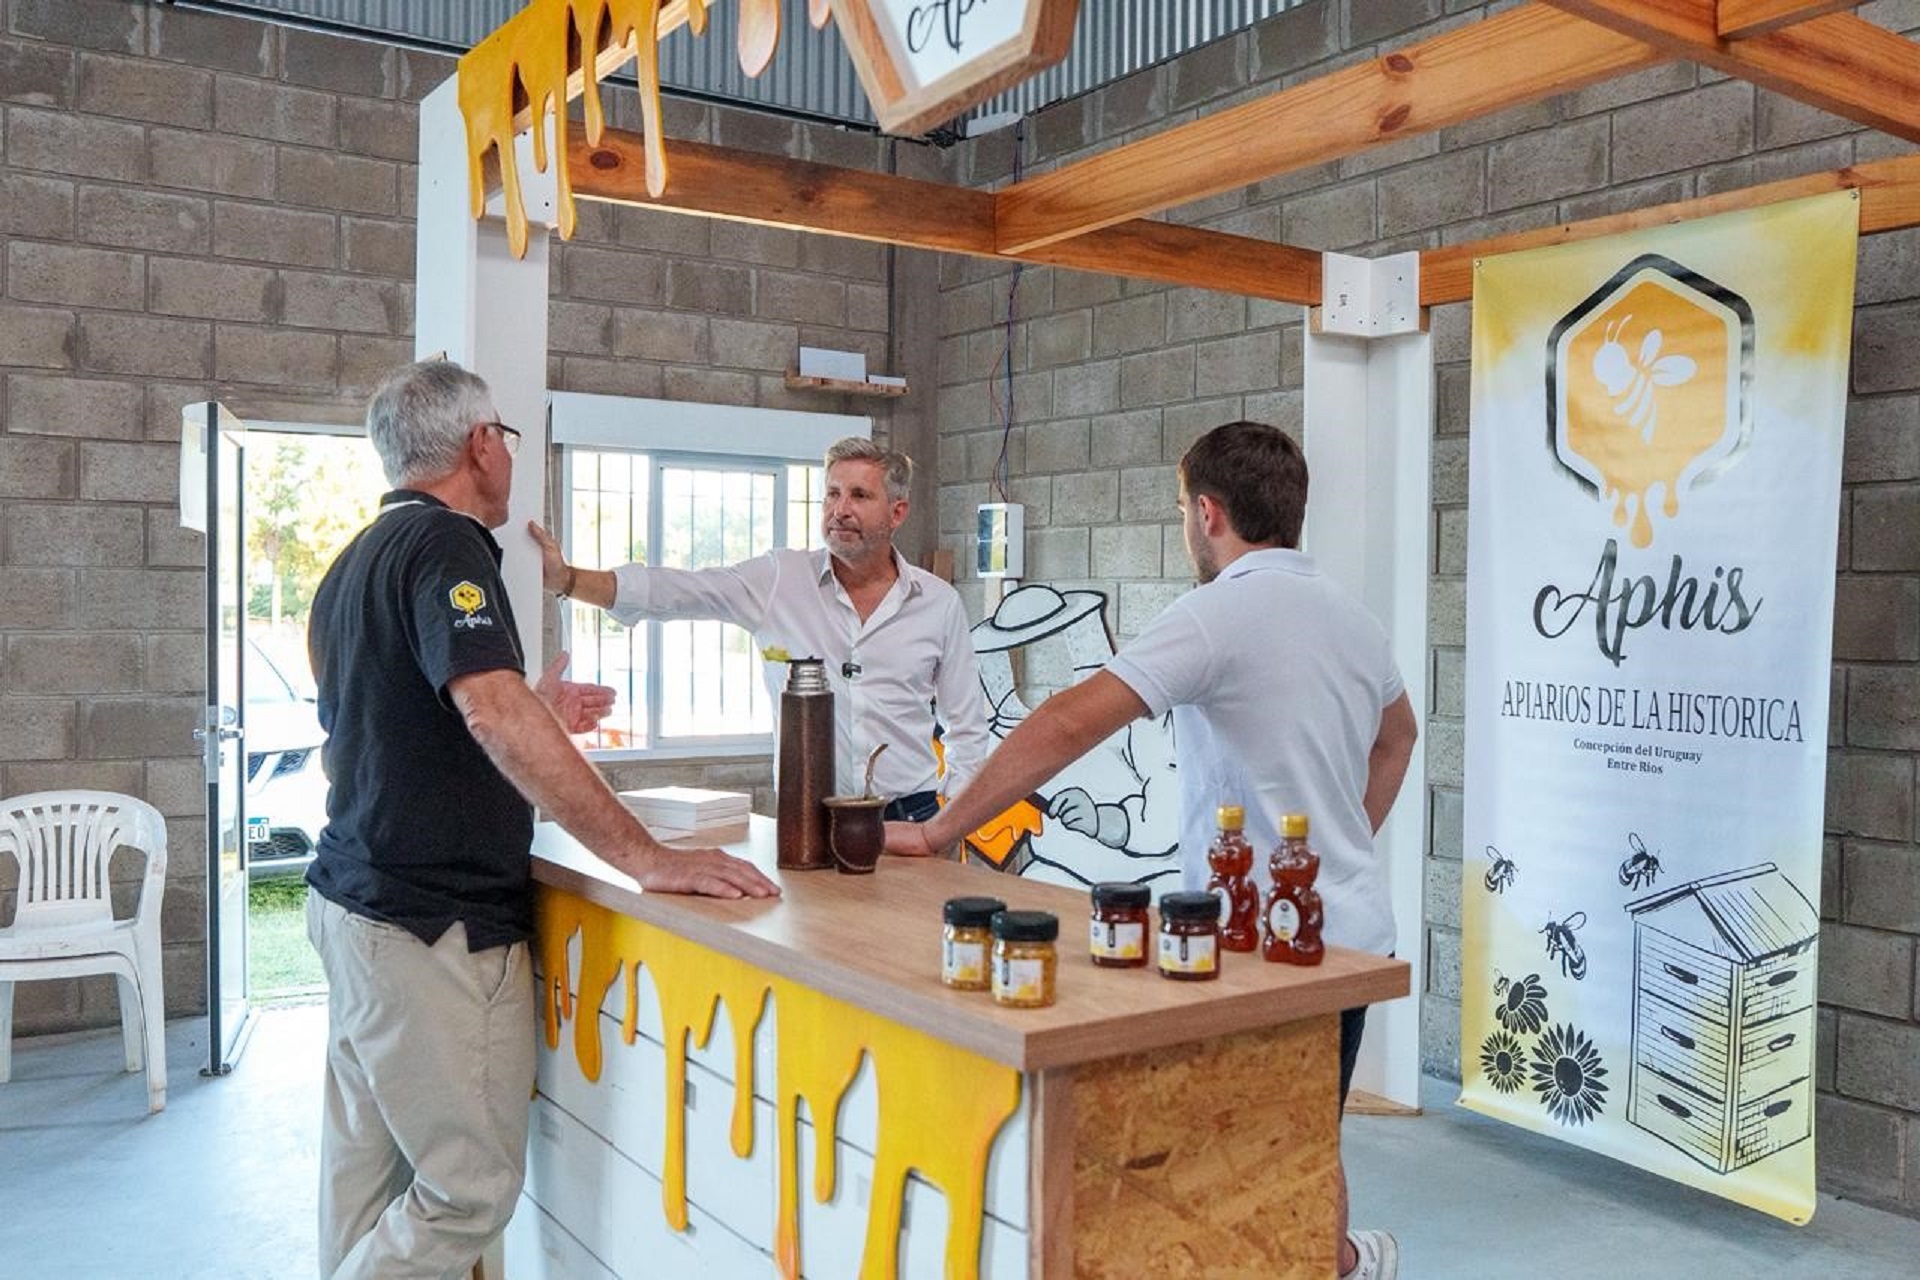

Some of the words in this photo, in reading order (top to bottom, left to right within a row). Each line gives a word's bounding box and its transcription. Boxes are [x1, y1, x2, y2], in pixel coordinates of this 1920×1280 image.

[1533, 538, 1763, 668] Aphis
[1501, 680, 1591, 724] APIARIOS
[1597, 687, 1626, 727] DE
[1632, 690, 1662, 730] LA
[1667, 692, 1803, 742] HISTORICA
[1573, 738, 1632, 754] Concepción
[1634, 744, 1652, 757] del
[1655, 746, 1702, 764] Uruguay
[1607, 758, 1637, 771] Entre
